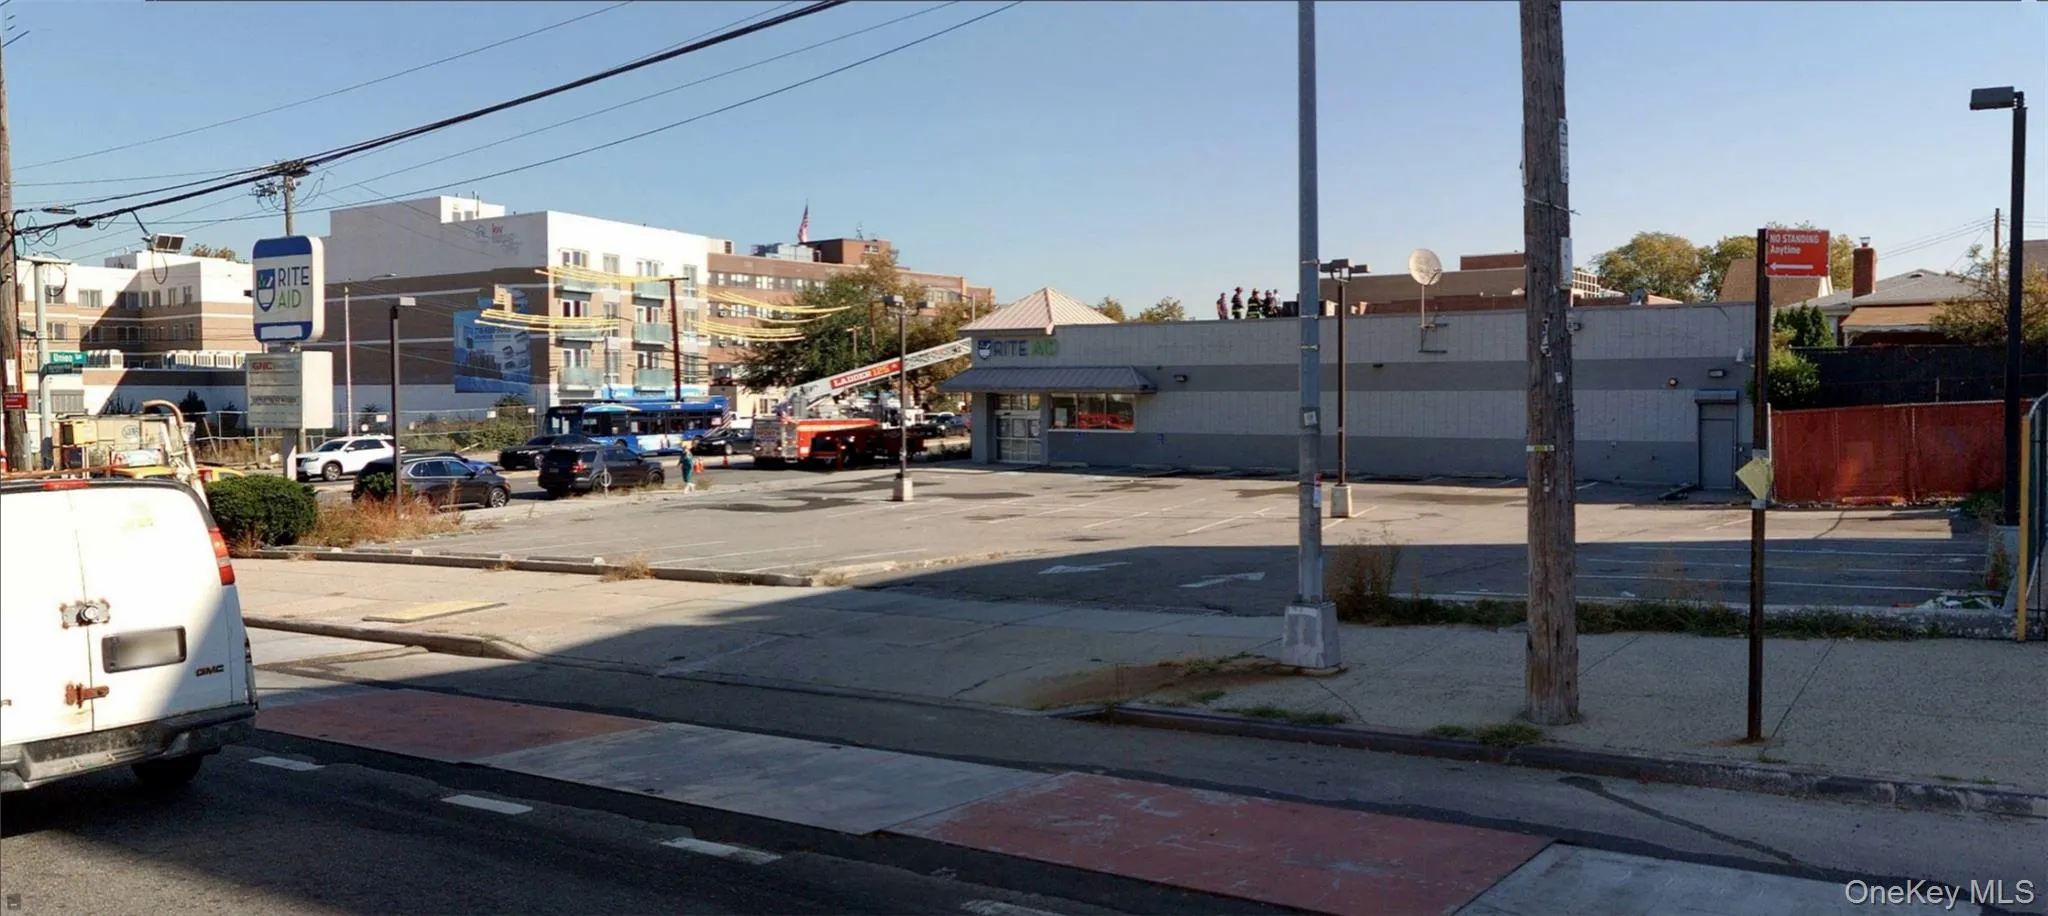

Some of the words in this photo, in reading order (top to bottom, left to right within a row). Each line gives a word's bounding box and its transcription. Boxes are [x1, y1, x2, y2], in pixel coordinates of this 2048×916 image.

[1769, 234, 1781, 244] NO
[1782, 234, 1820, 244] STANDING
[1769, 245, 1801, 256] Anytime
[278, 266, 310, 288] RITE
[277, 289, 302, 309] AID
[994, 340, 1028, 357] RITE
[1031, 340, 1059, 356] AID
[834, 369, 873, 387] LADDER
[196, 664, 224, 677] GMC
